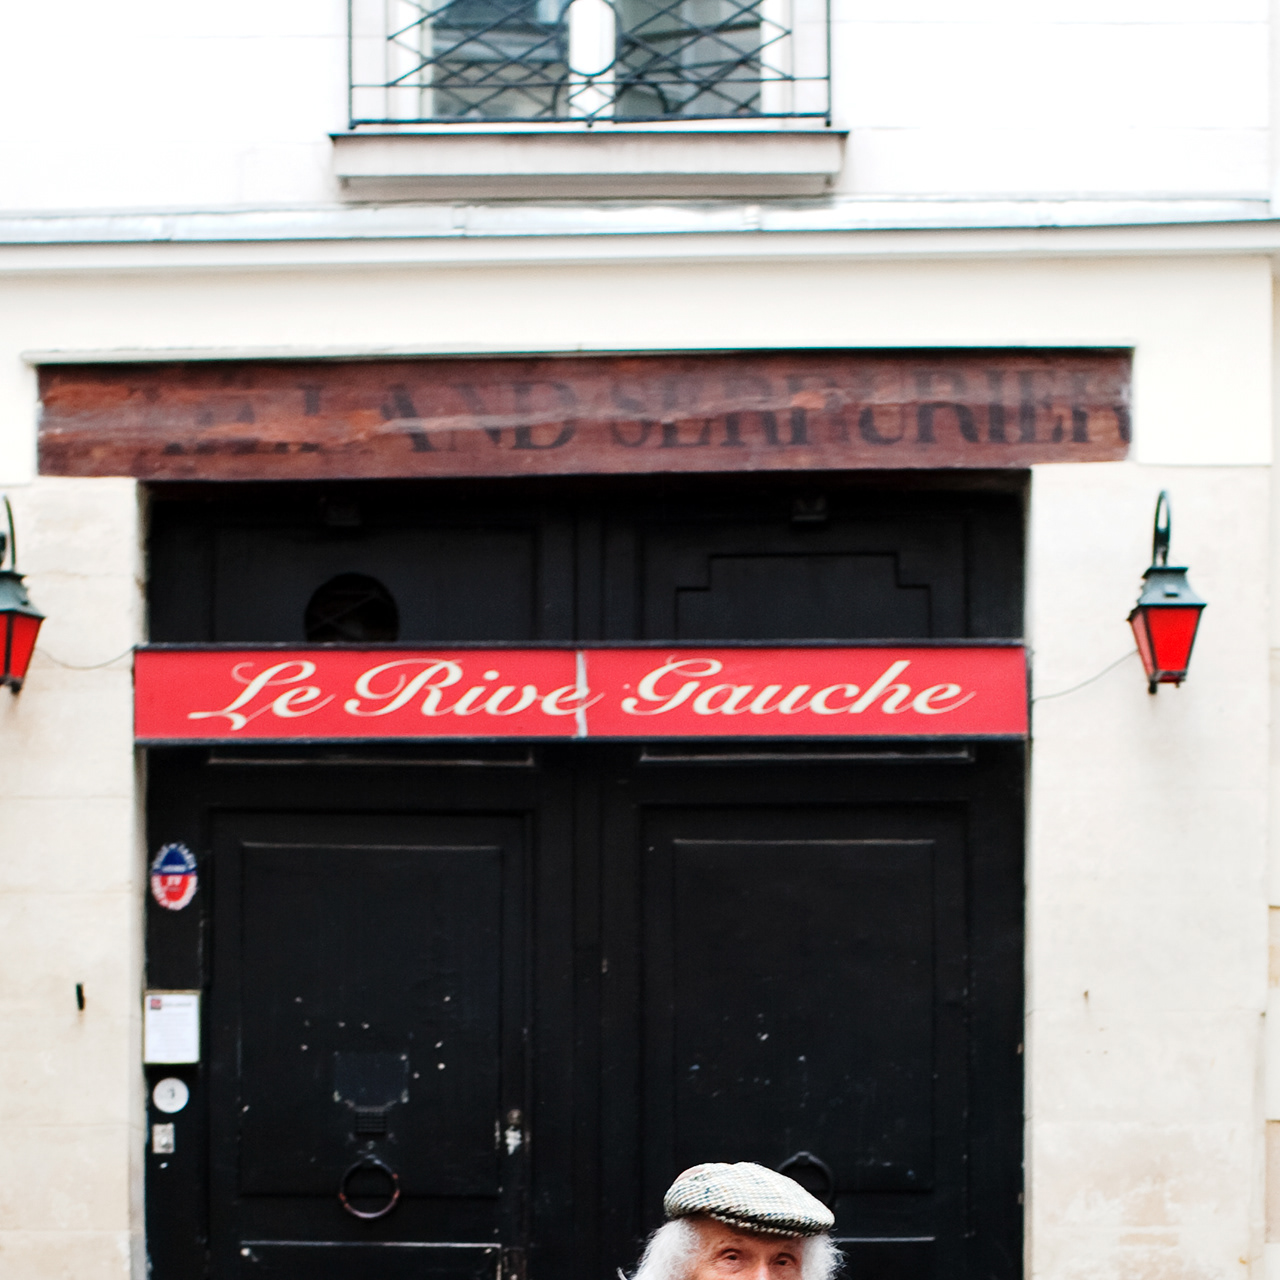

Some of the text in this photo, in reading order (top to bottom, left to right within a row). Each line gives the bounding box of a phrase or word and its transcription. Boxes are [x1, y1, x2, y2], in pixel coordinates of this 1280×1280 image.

[187, 653, 977, 731] Le Rive Gauche
